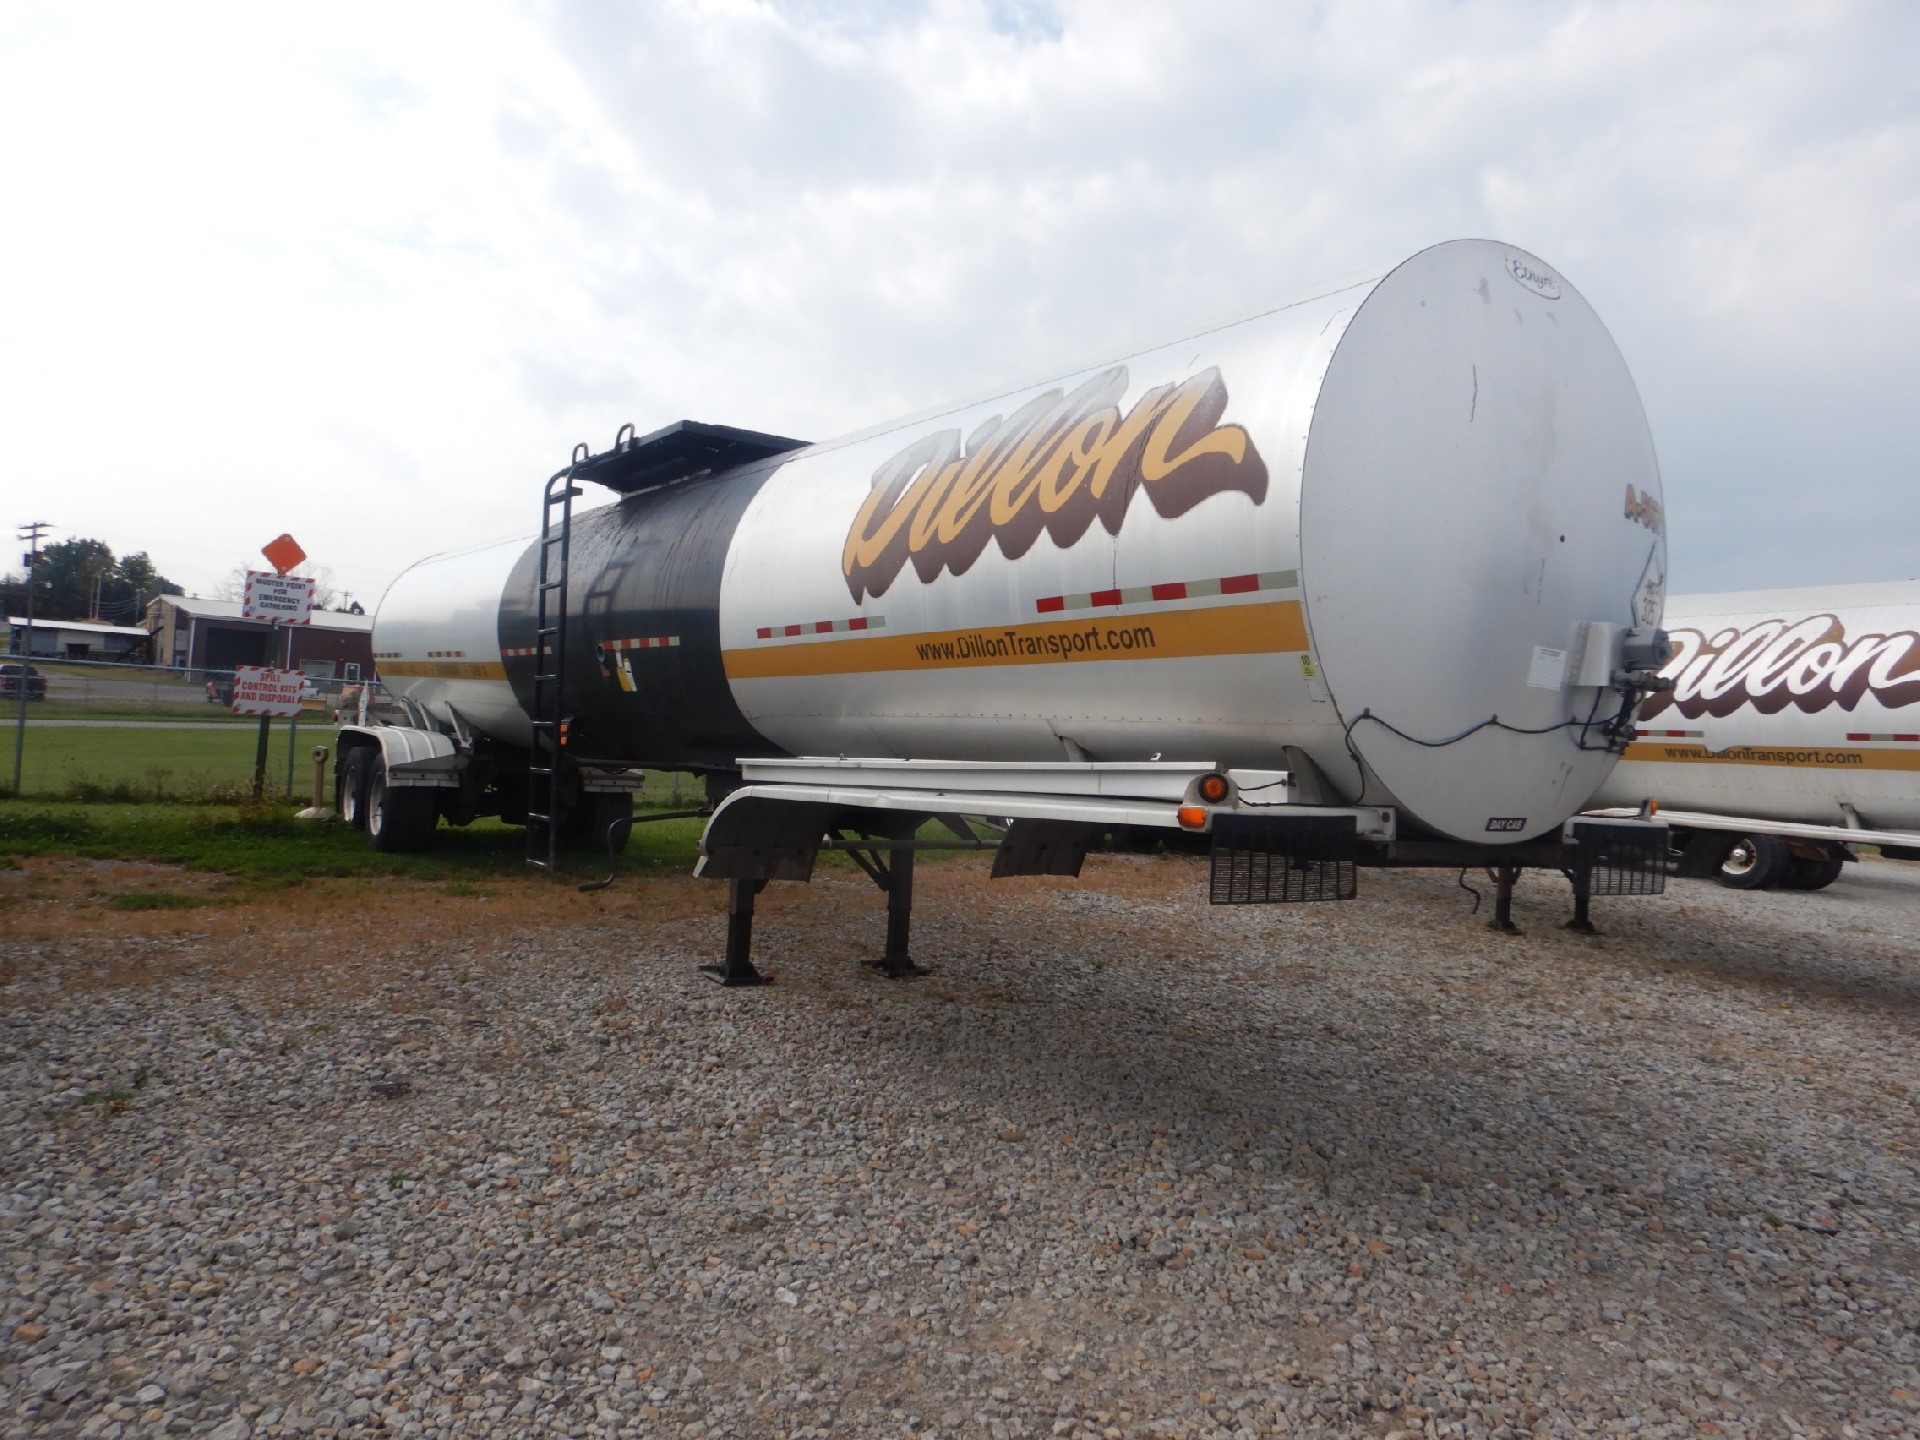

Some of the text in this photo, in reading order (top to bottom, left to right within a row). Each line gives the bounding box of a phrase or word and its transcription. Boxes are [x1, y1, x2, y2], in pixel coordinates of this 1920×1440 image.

[842, 364, 1269, 606] Dillon
[256, 578, 284, 587] MUSTER
[258, 594, 301, 605] EMERGENCY
[259, 602, 298, 611] GATHERING
[916, 626, 1157, 662] www.DillonTransport.com
[260, 672, 281, 682] SPILL
[242, 681, 297, 693] CONTROL KITS
[240, 692, 296, 703] AND DISPOSAL
